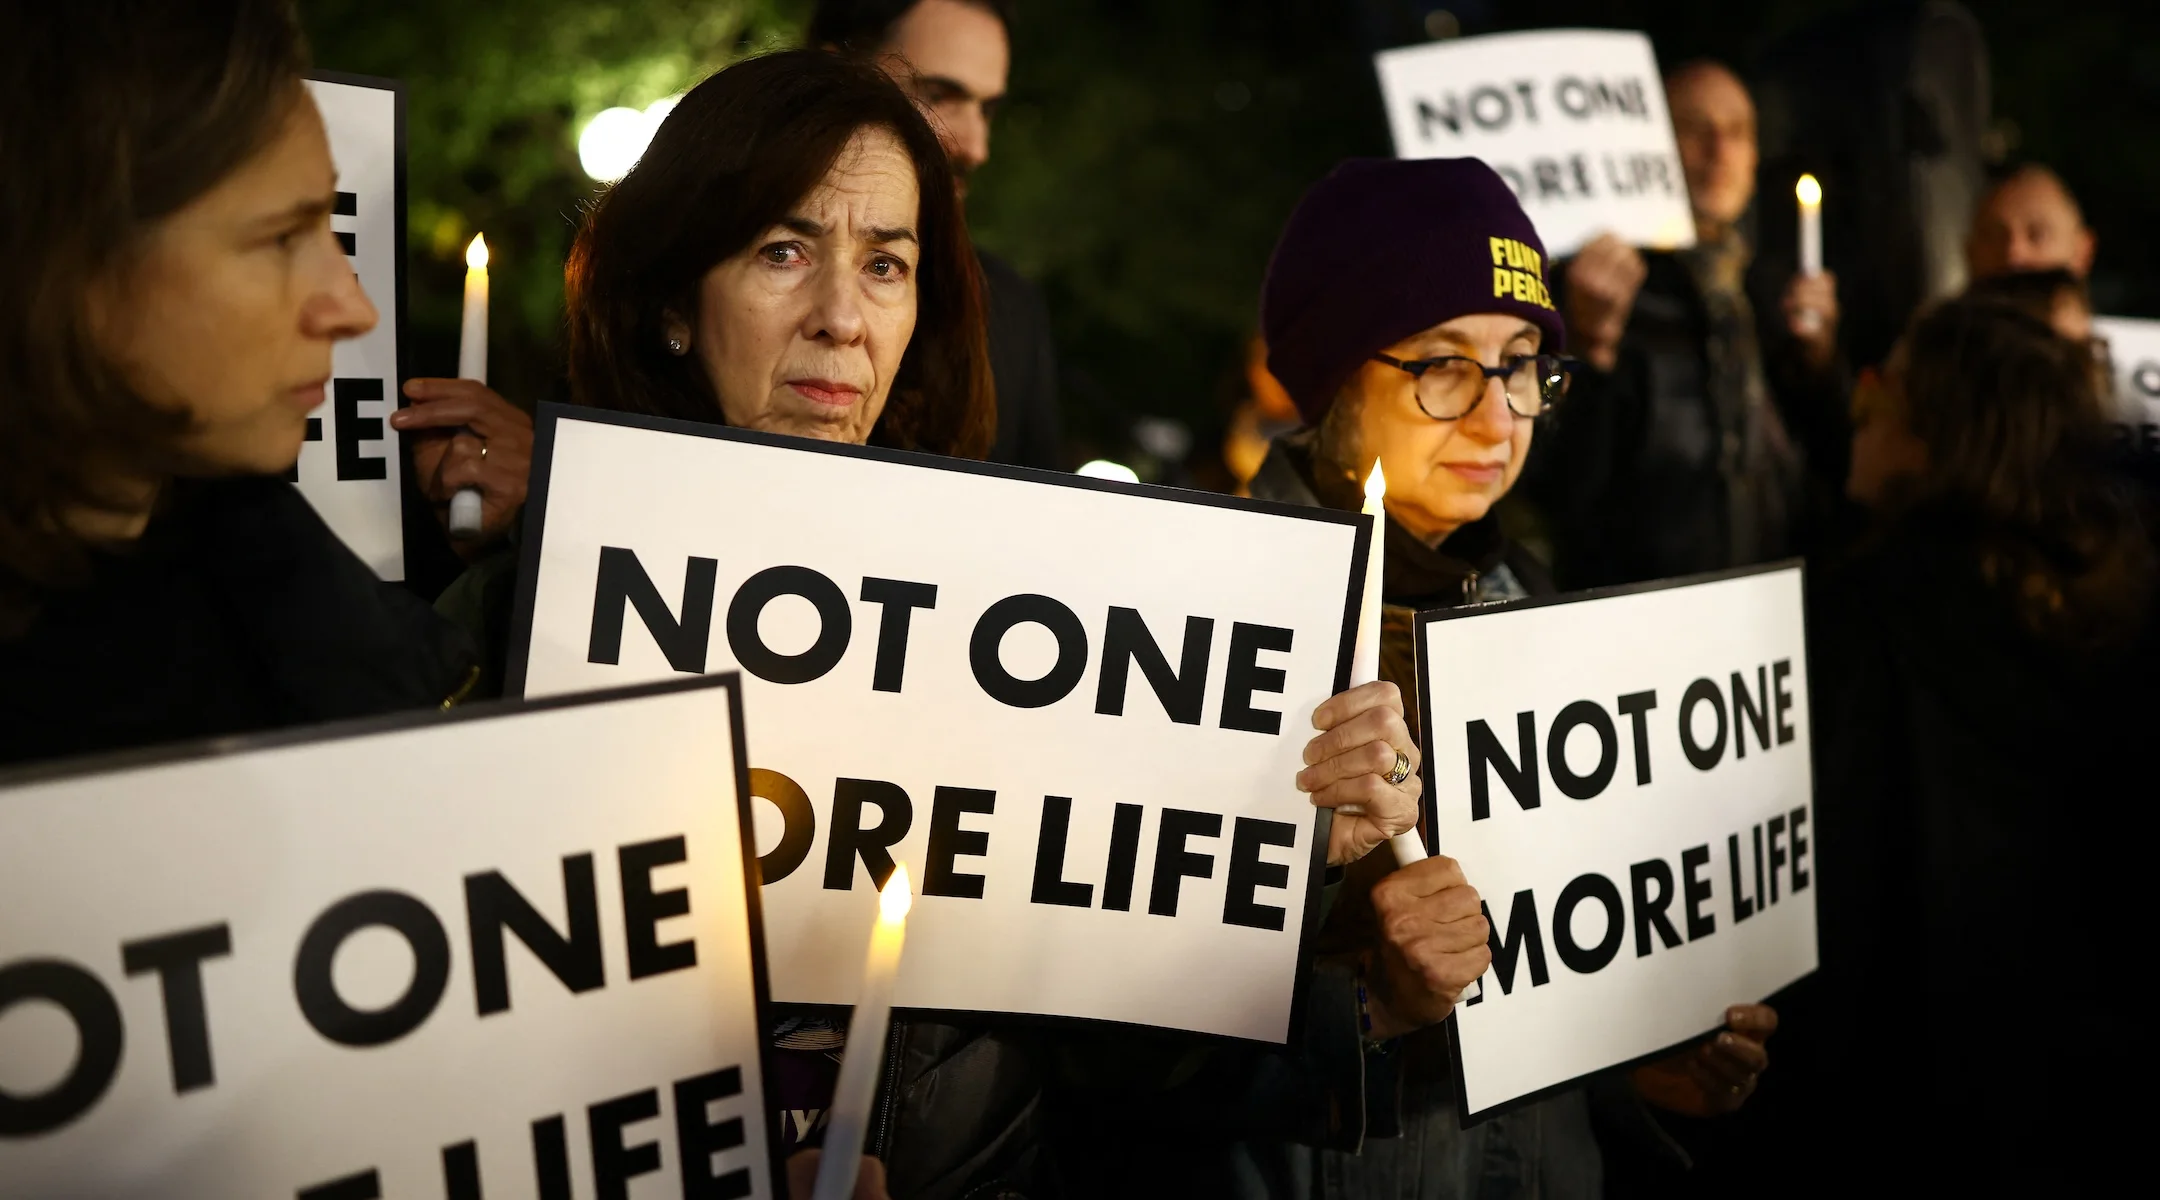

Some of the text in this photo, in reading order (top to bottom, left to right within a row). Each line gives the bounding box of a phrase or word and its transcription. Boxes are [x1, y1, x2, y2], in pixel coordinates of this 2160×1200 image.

[1415, 75, 1652, 139] NOT ONE
[587, 545, 1294, 736] NOT ONE
[1466, 657, 1795, 822] NOT ONE
[747, 767, 1297, 932] ORE LIFE
[1466, 804, 1809, 1008] MORE LIFE
[0, 834, 698, 1141] OT ONE
